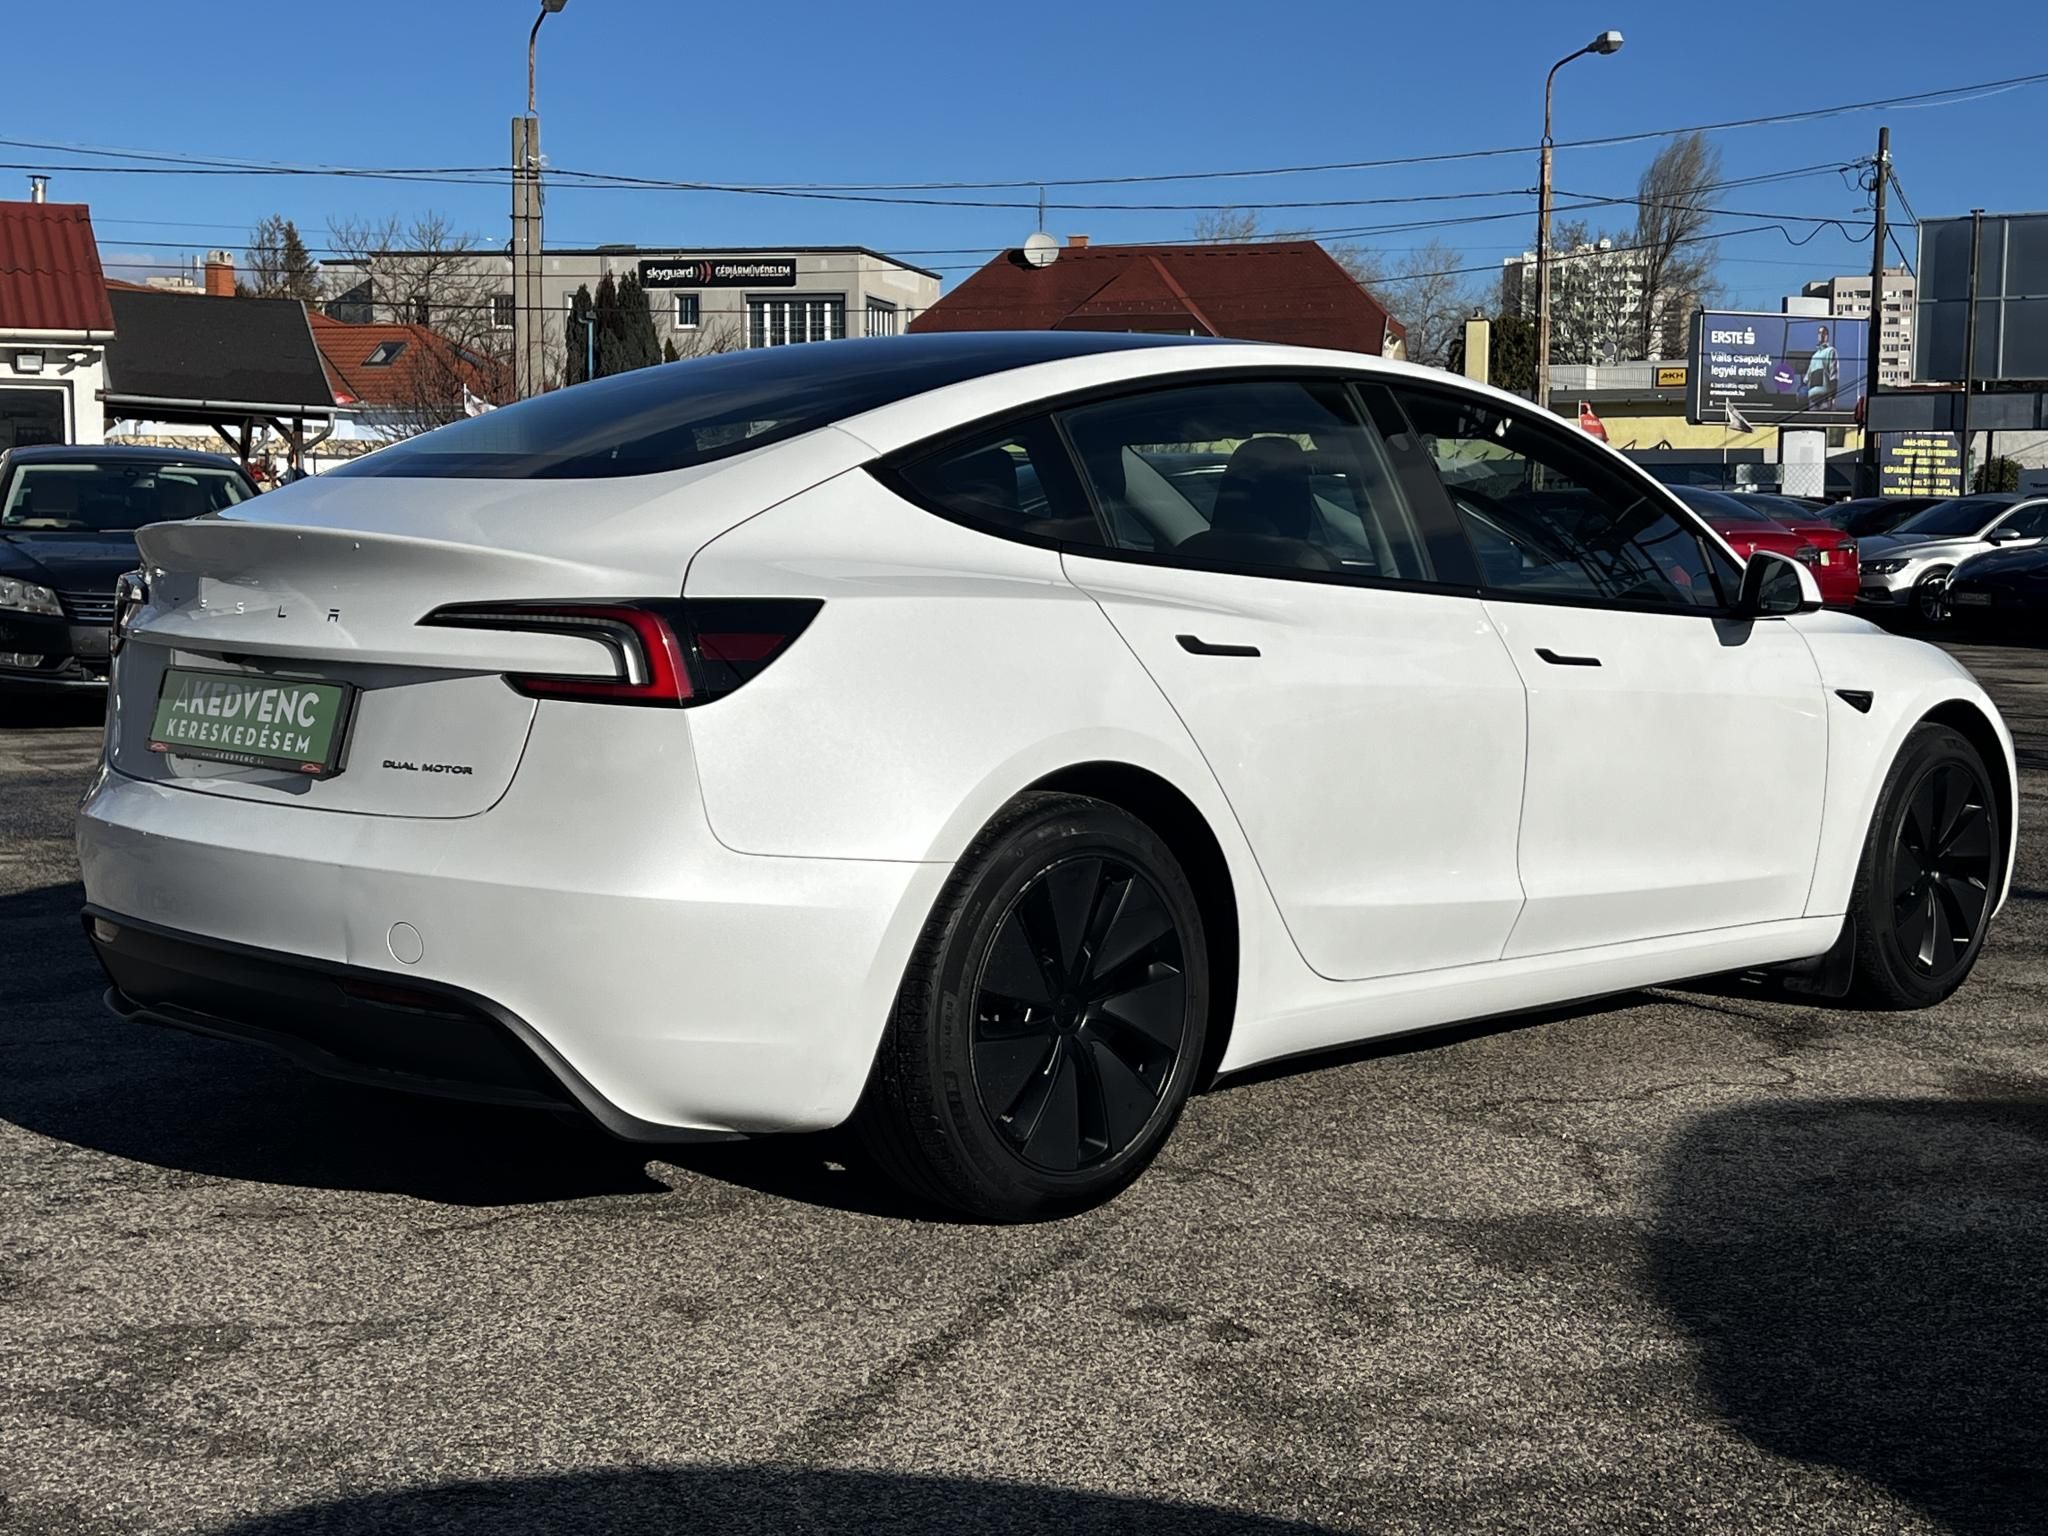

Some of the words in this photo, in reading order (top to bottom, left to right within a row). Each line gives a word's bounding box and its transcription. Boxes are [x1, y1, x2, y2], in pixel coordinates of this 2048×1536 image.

[646, 266, 694, 280] skyguard
[1711, 330, 1744, 344] ERSTE
[1711, 351, 1732, 362] Válts
[1711, 365, 1737, 378] legyél
[1738, 366, 1767, 377] erstés!
[166, 718, 311, 754] KERESKEDÉSEM
[382, 760, 419, 771] DUAL
[421, 763, 473, 775] MOTOR
